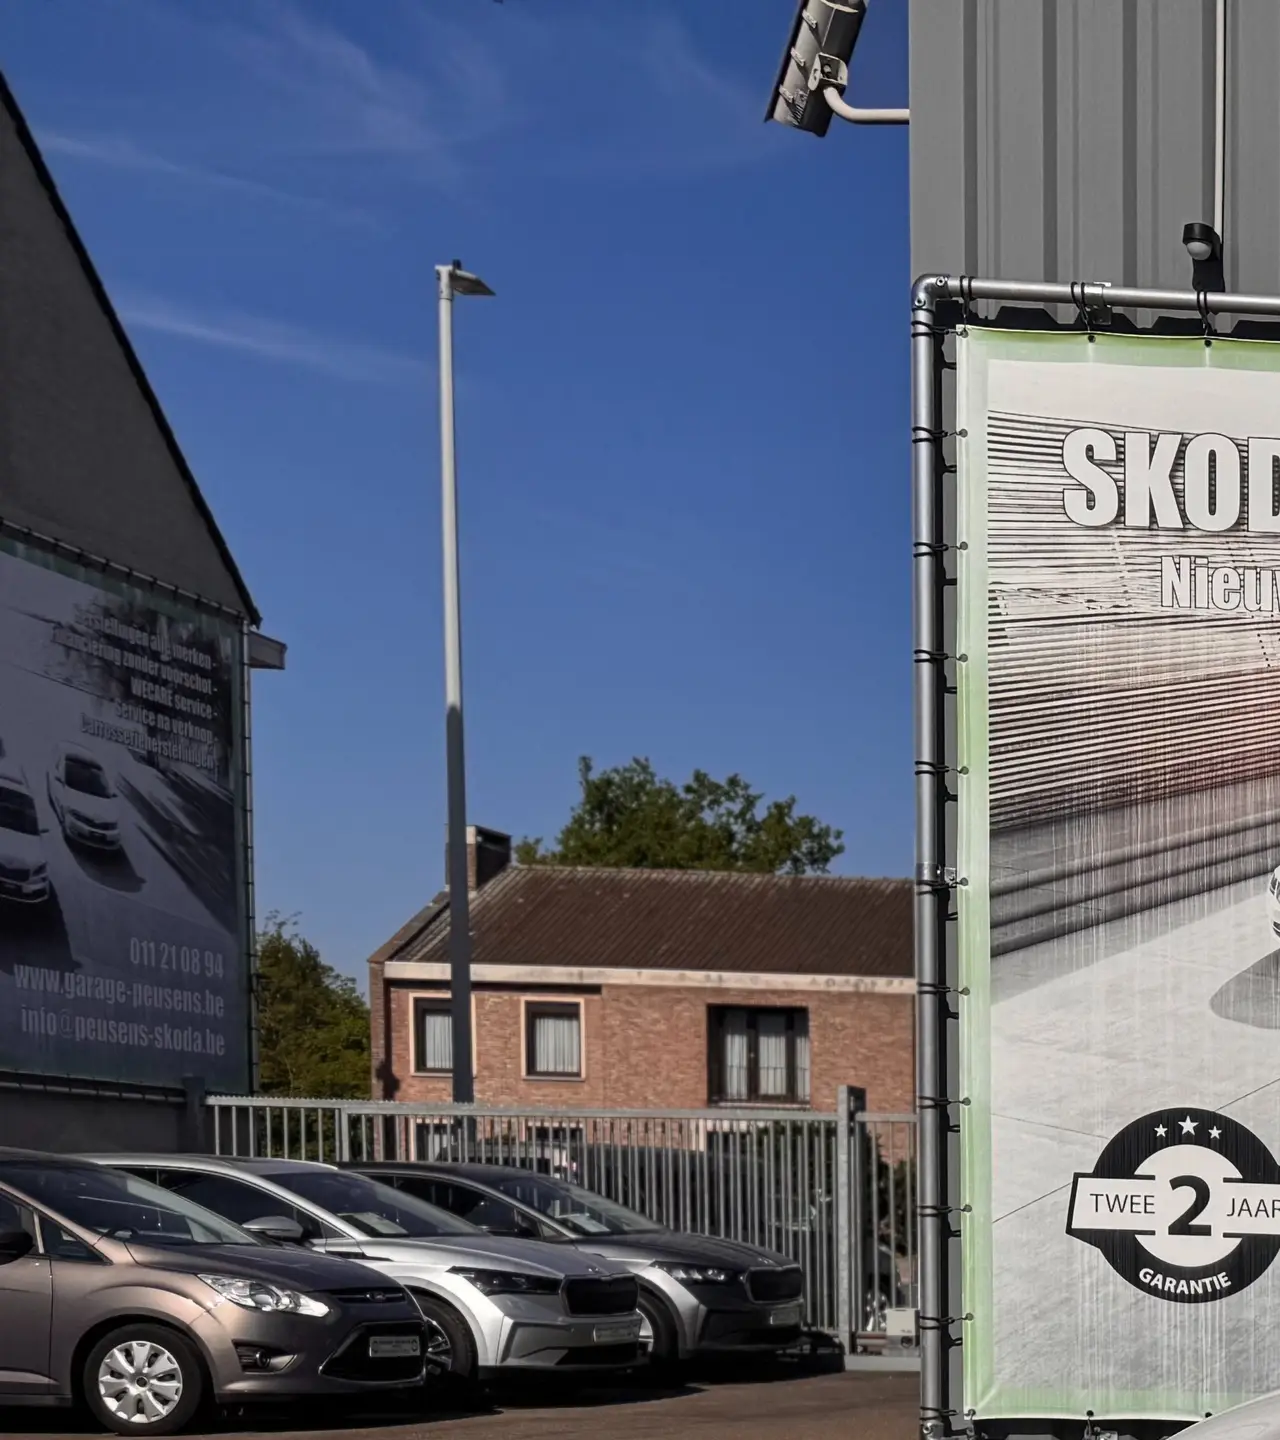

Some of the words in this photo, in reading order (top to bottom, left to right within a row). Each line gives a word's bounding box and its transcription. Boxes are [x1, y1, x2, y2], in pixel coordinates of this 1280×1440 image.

[130, 675, 174, 710] WECARE
[174, 693, 213, 721] service
[130, 936, 156, 967] 011
[159, 941, 178, 971] 21
[179, 946, 201, 975] 08
[204, 949, 224, 979] 94
[13, 962, 225, 1018] www.garage-peusens.be
[21, 1004, 226, 1056] info@peusens-skoda.be
[1089, 1193, 1156, 1215] TWEE
[1167, 1174, 1212, 1237] 2
[1138, 1266, 1232, 1295] GARANTIE
